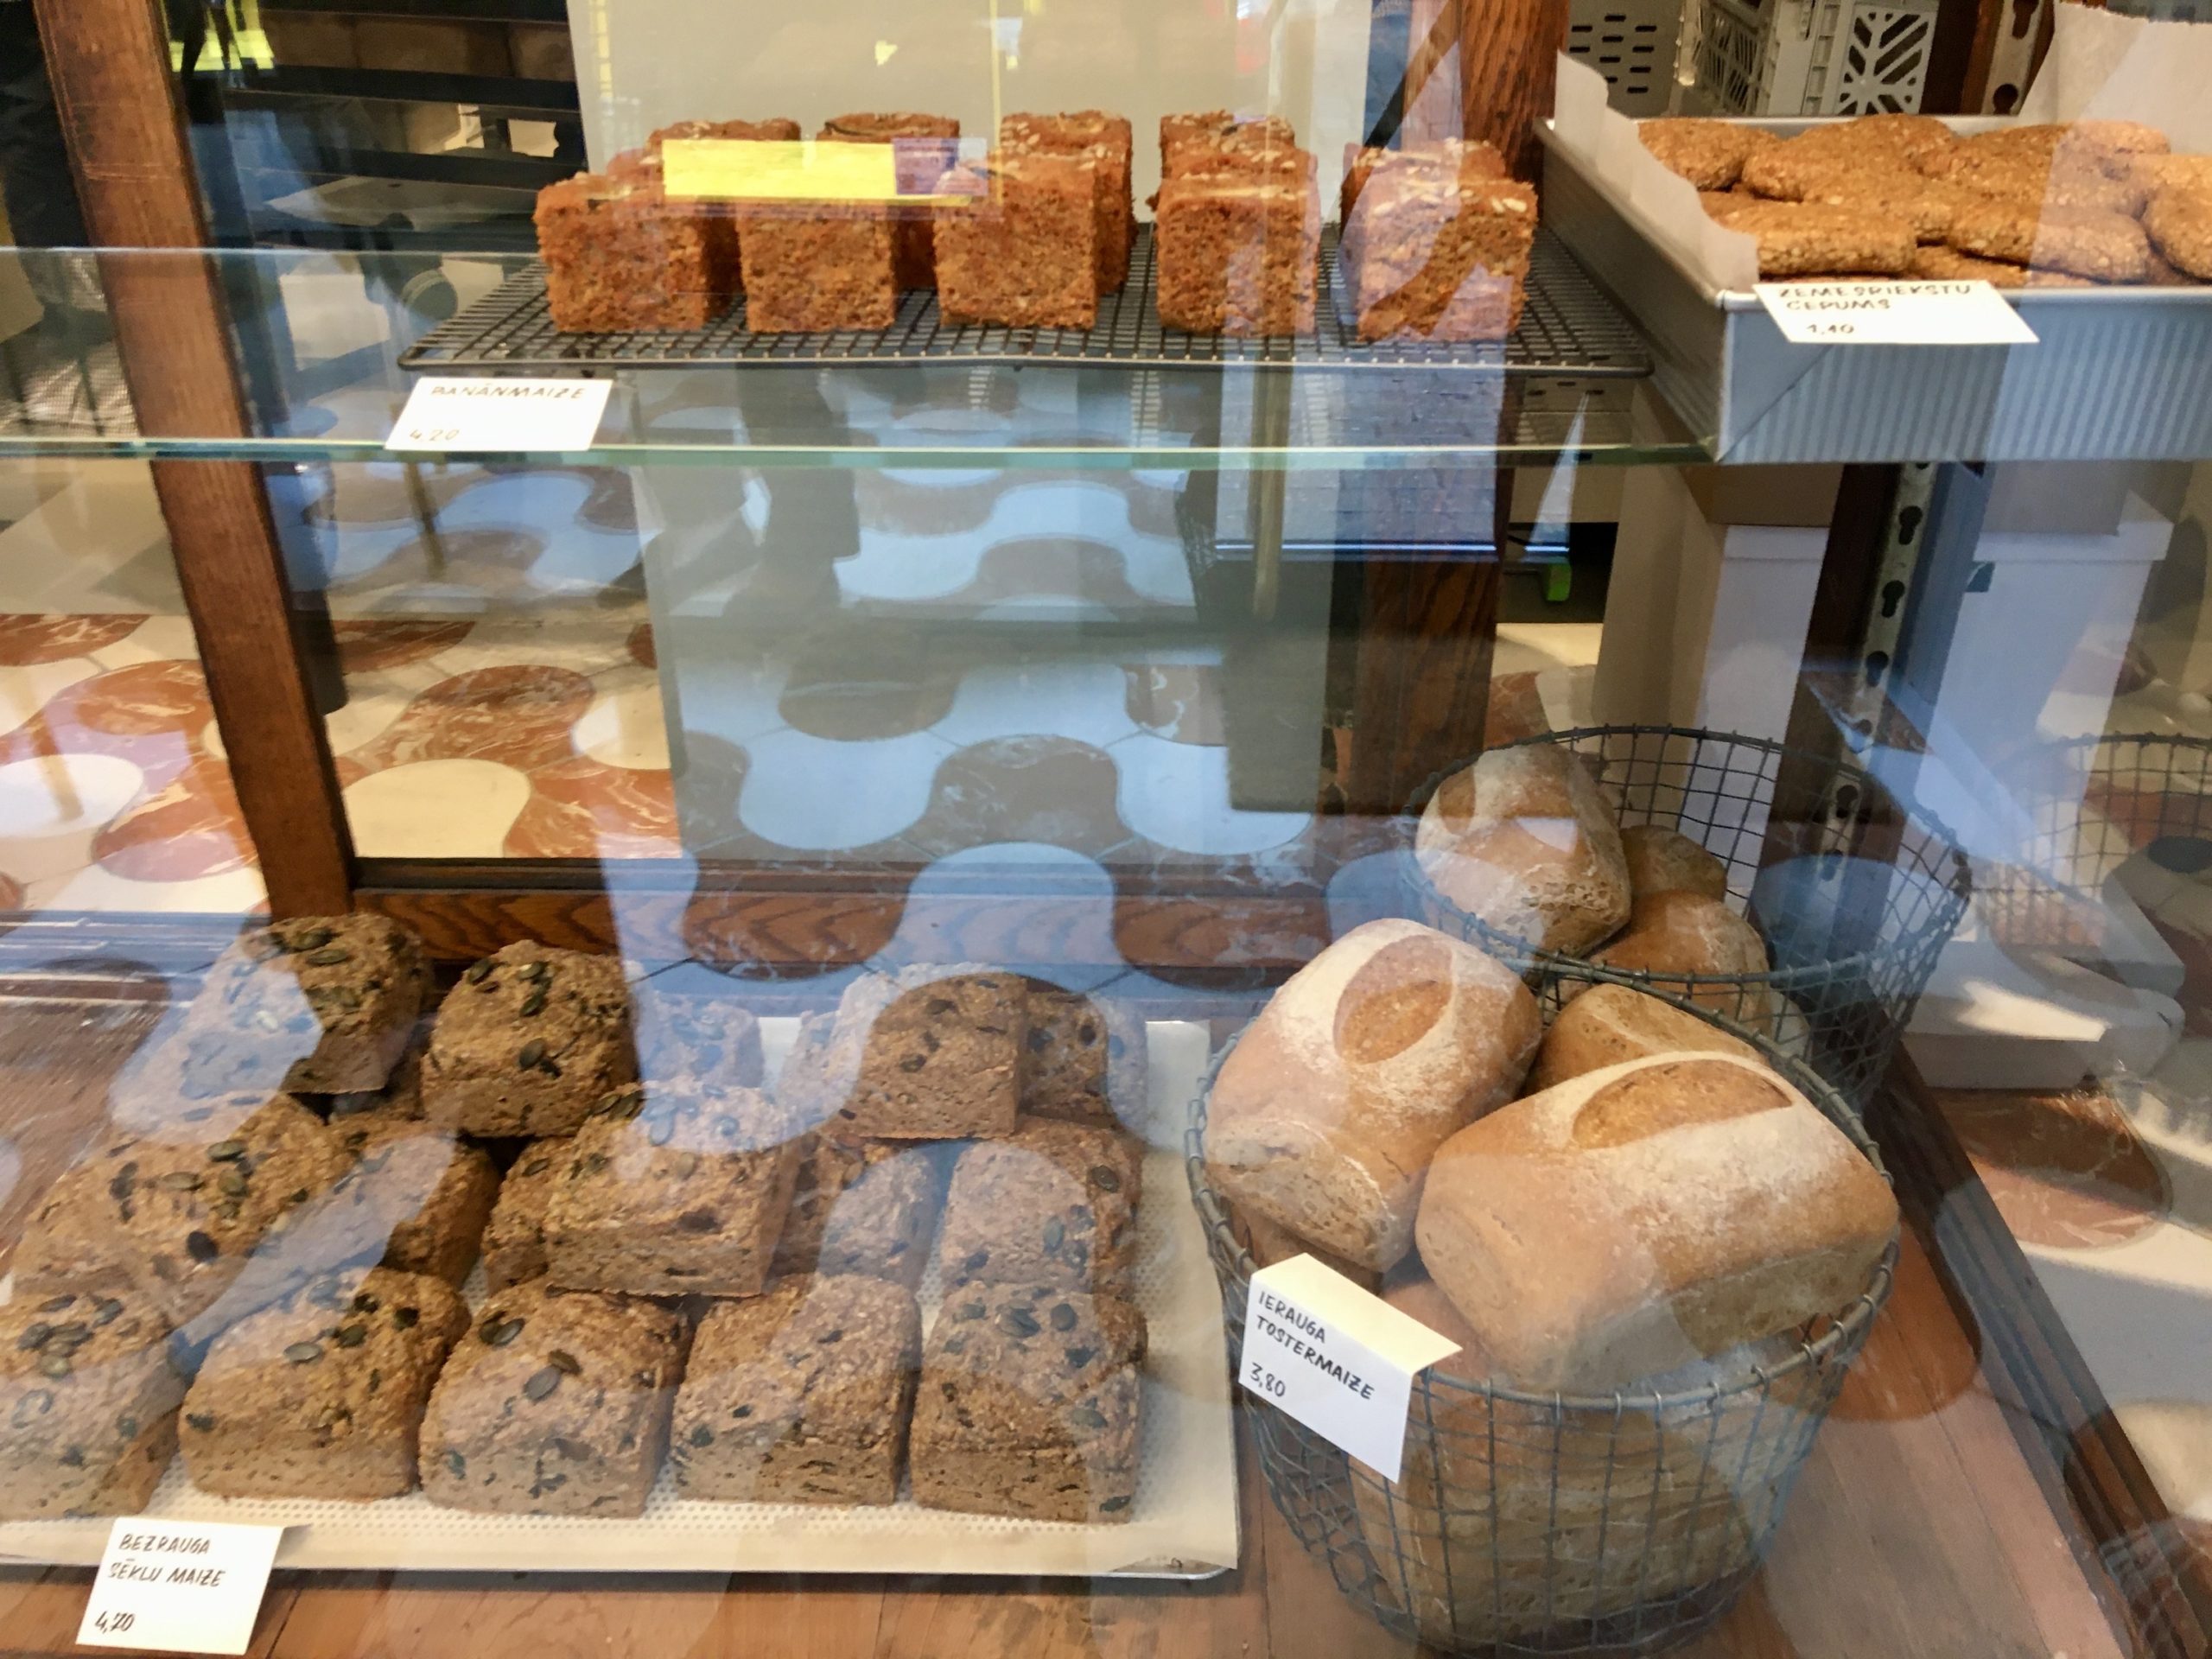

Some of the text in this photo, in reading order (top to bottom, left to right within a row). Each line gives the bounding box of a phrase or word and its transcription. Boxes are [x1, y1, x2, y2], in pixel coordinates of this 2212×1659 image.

[1258, 1291, 1325, 1343] IERAUGA
[1257, 1315, 1375, 1400] TOSTERMAIZE
[1249, 1362, 1287, 1397] 3,80
[166, 1567, 226, 1586] MAIZE
